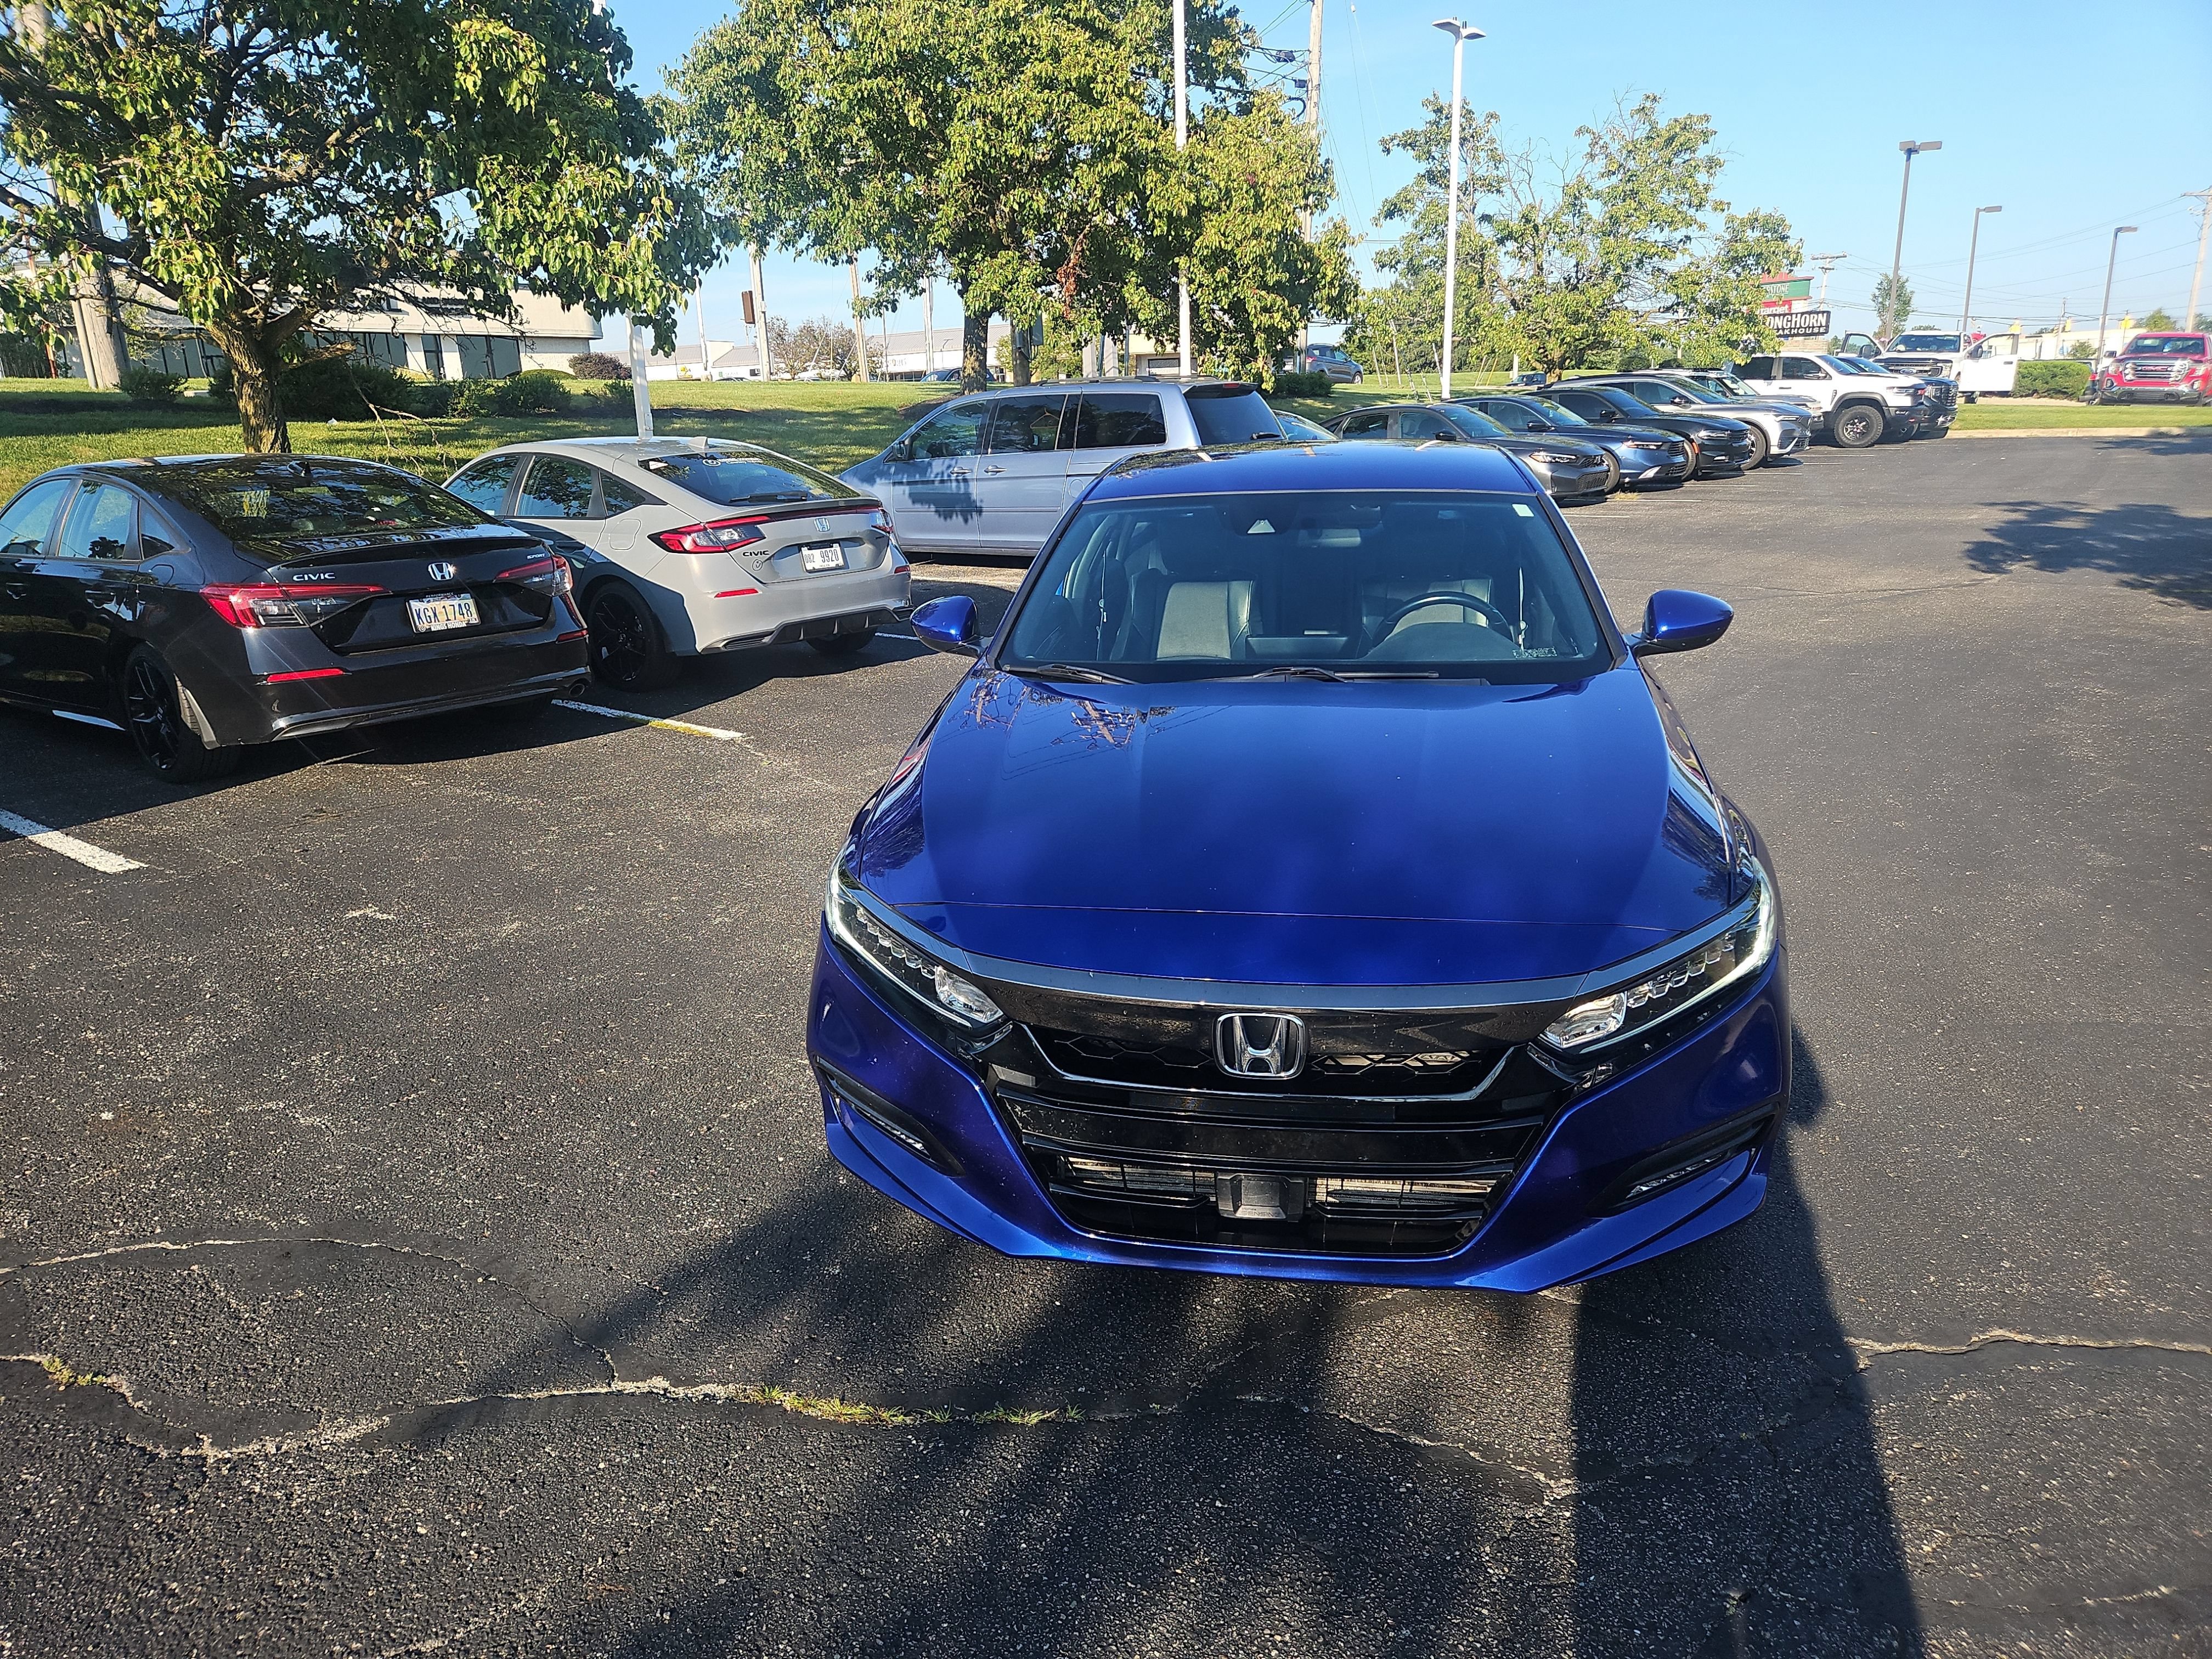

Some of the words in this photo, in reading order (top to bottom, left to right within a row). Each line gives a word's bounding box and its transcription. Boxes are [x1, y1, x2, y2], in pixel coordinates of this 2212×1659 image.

[1765, 313, 1827, 329] ONGHORN
[820, 549, 839, 563] 9920
[292, 572, 336, 582] CIVIC
[415, 606, 439, 625] KGX
[442, 602, 473, 622] 1748
[431, 623, 448, 631] KINGS
[447, 620, 467, 629] HONDA
